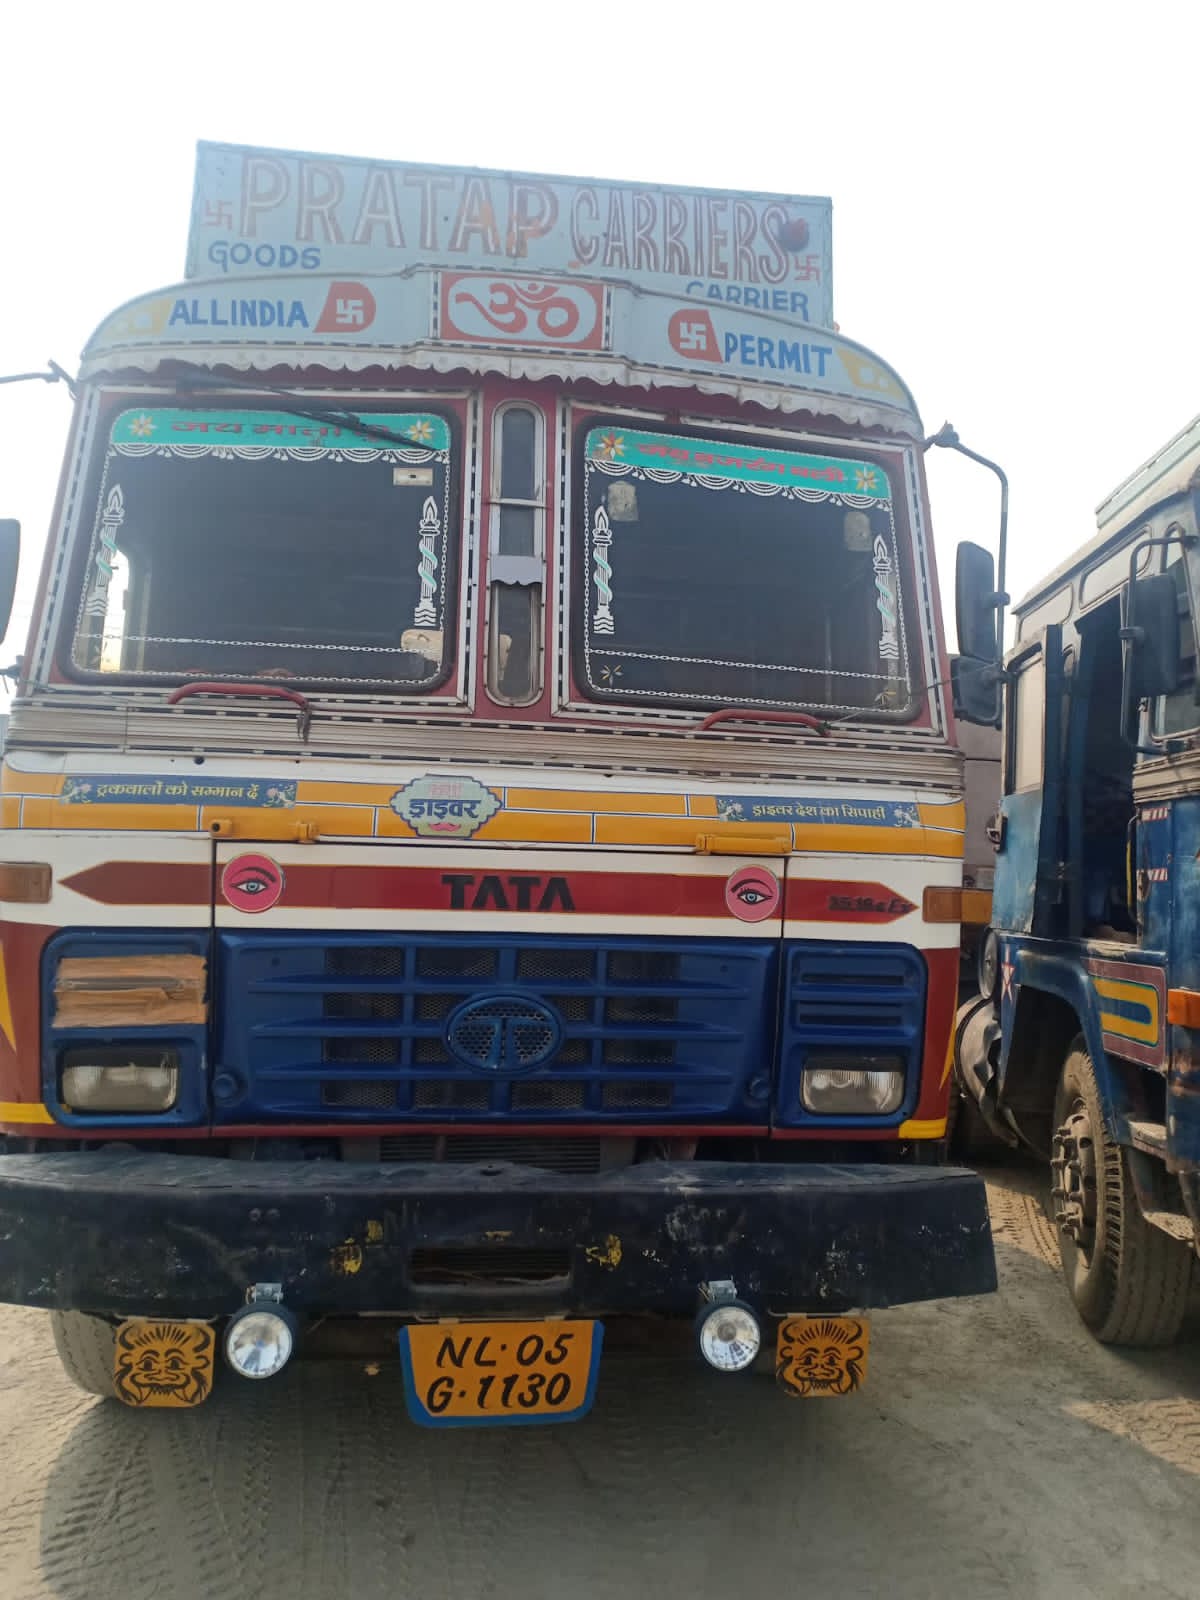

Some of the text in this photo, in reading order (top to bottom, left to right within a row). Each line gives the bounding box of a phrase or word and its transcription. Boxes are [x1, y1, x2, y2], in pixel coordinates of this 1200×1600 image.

[239, 154, 791, 286] PRATAP CARRIERS
[208, 241, 321, 271] GOODS
[723, 332, 833, 377] PERMIT
[165, 780, 187, 796] को
[191, 784, 244, 798] सम्मान
[409, 799, 482, 820] ड्राइवर
[752, 801, 887, 820] ड्राइवर देश का सिपाही
[441, 874, 576, 912] TATA
